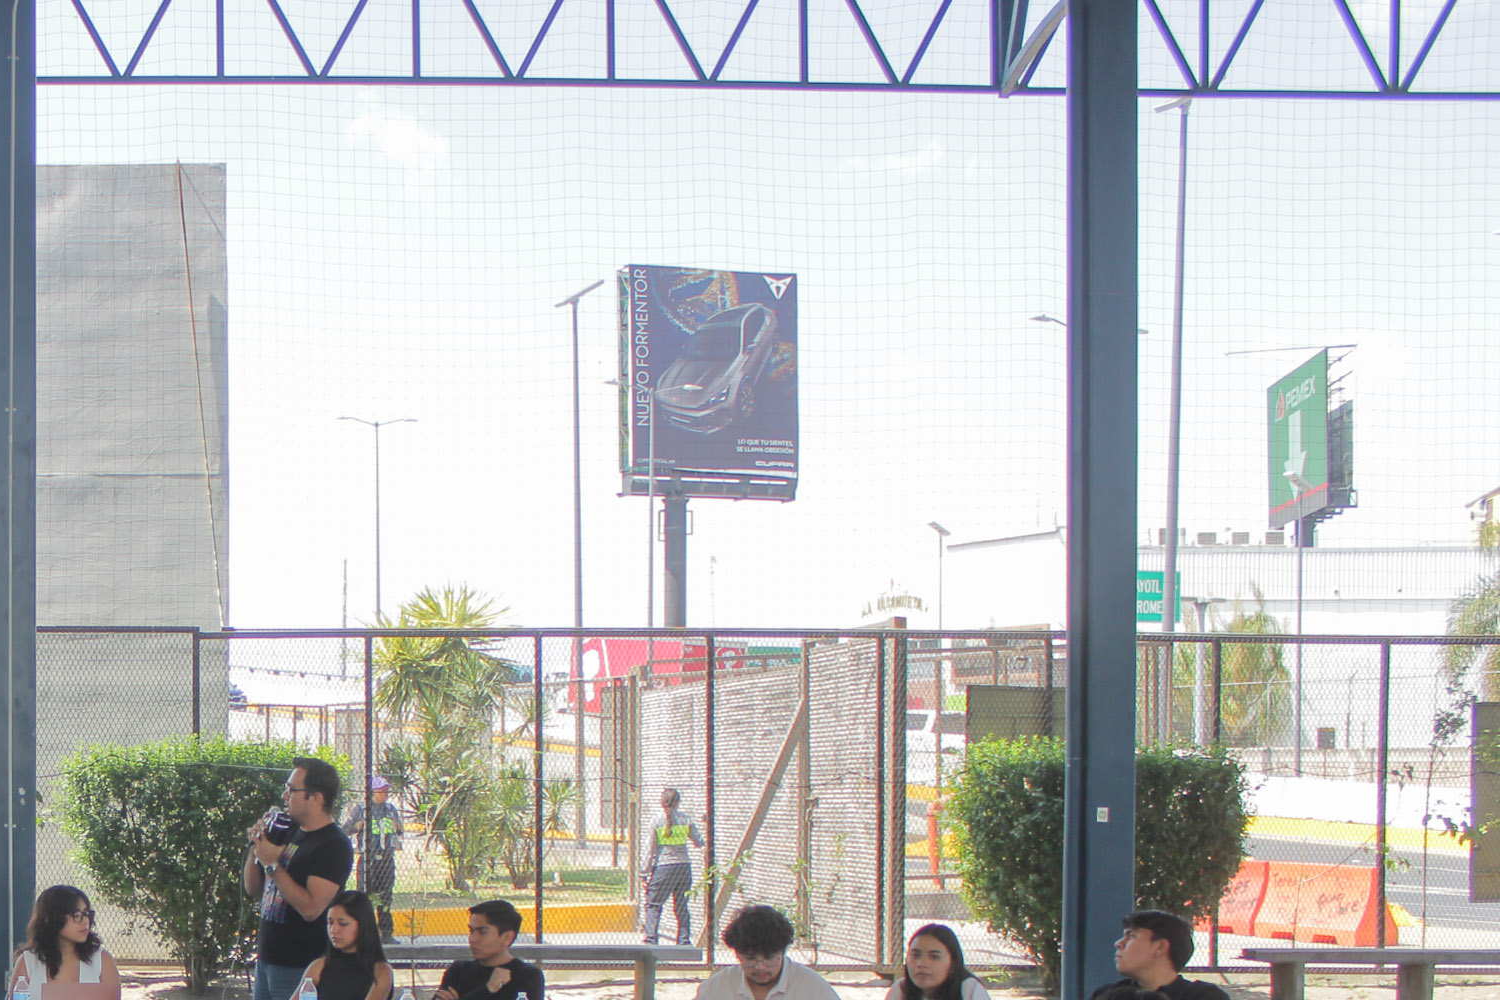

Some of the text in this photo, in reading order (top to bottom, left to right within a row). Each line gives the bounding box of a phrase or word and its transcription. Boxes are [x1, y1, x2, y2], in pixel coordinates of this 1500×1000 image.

[634, 268, 650, 426] NUEVO FORMENTOR
[1285, 375, 1316, 412] PEMEX
